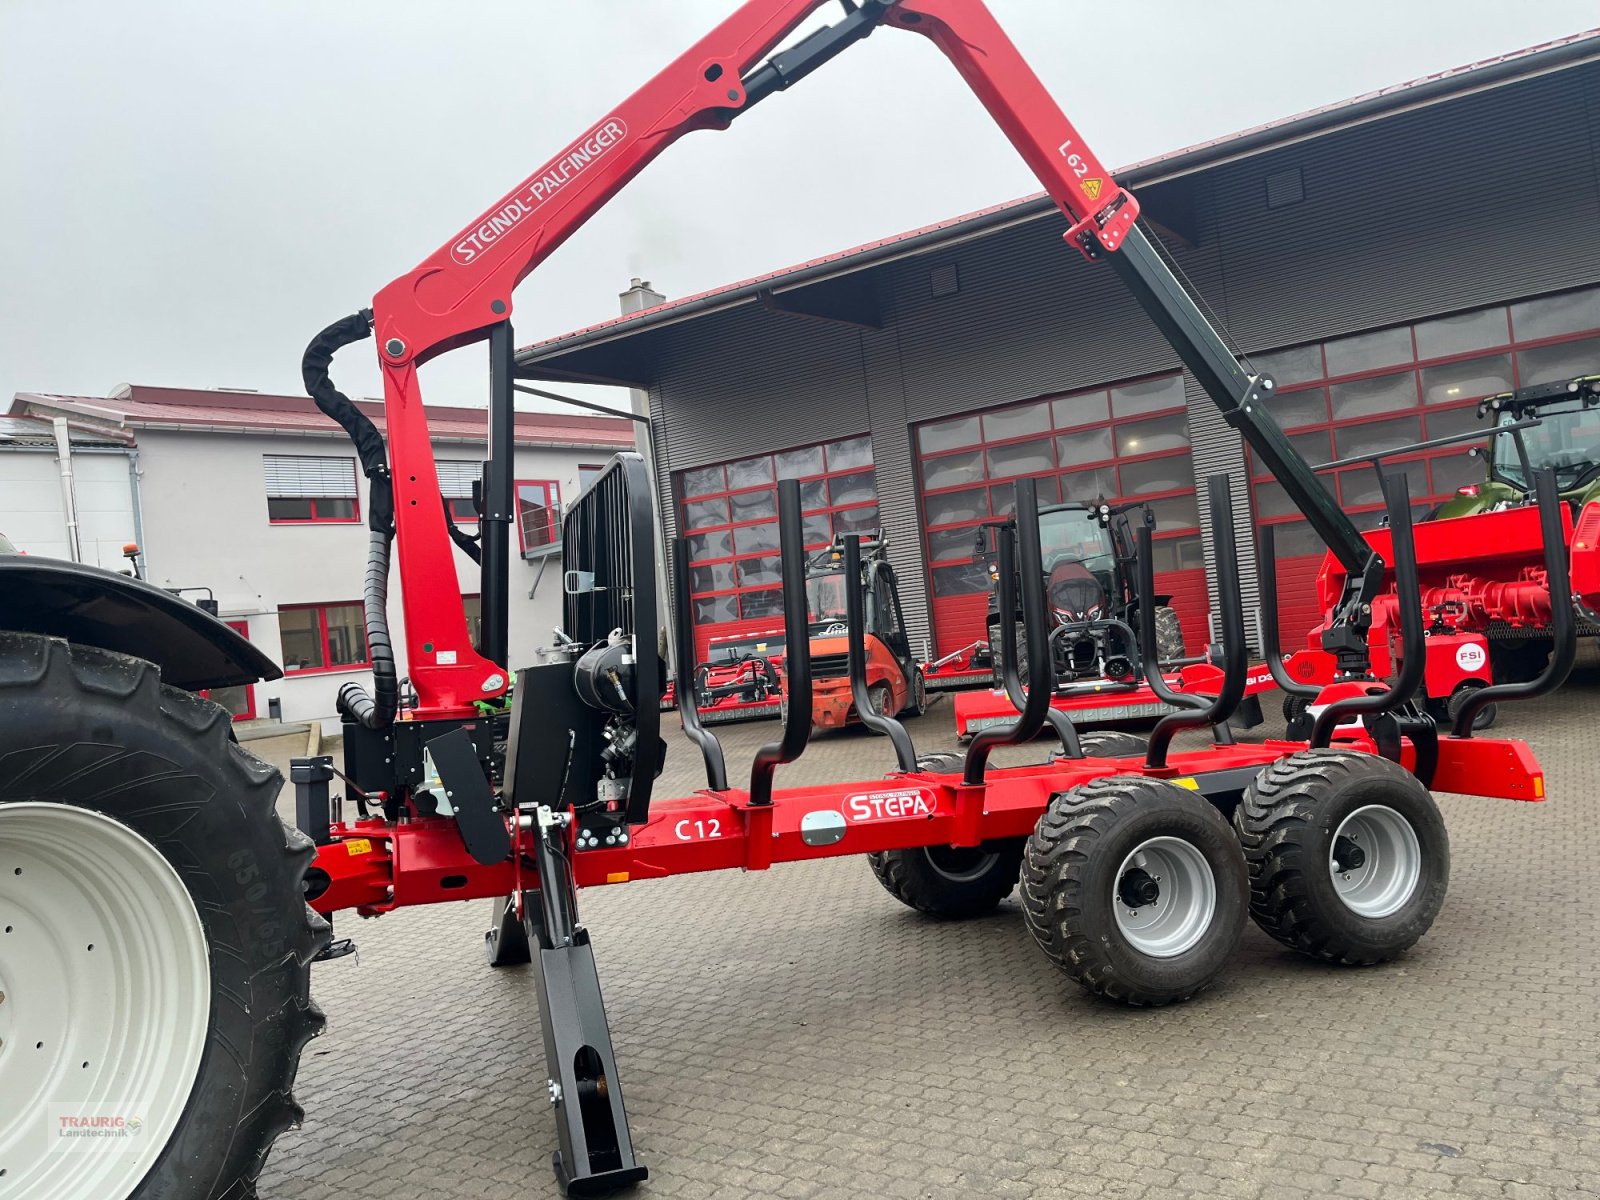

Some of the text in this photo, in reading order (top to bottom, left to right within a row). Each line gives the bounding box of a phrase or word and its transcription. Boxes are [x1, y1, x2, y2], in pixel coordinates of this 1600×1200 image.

[1058, 139, 1088, 178] L62
[456, 121, 623, 261] STEINDL-PALFINGER
[818, 622, 848, 636] Lind
[1460, 651, 1481, 661] FSI
[850, 795, 929, 820] STEPA
